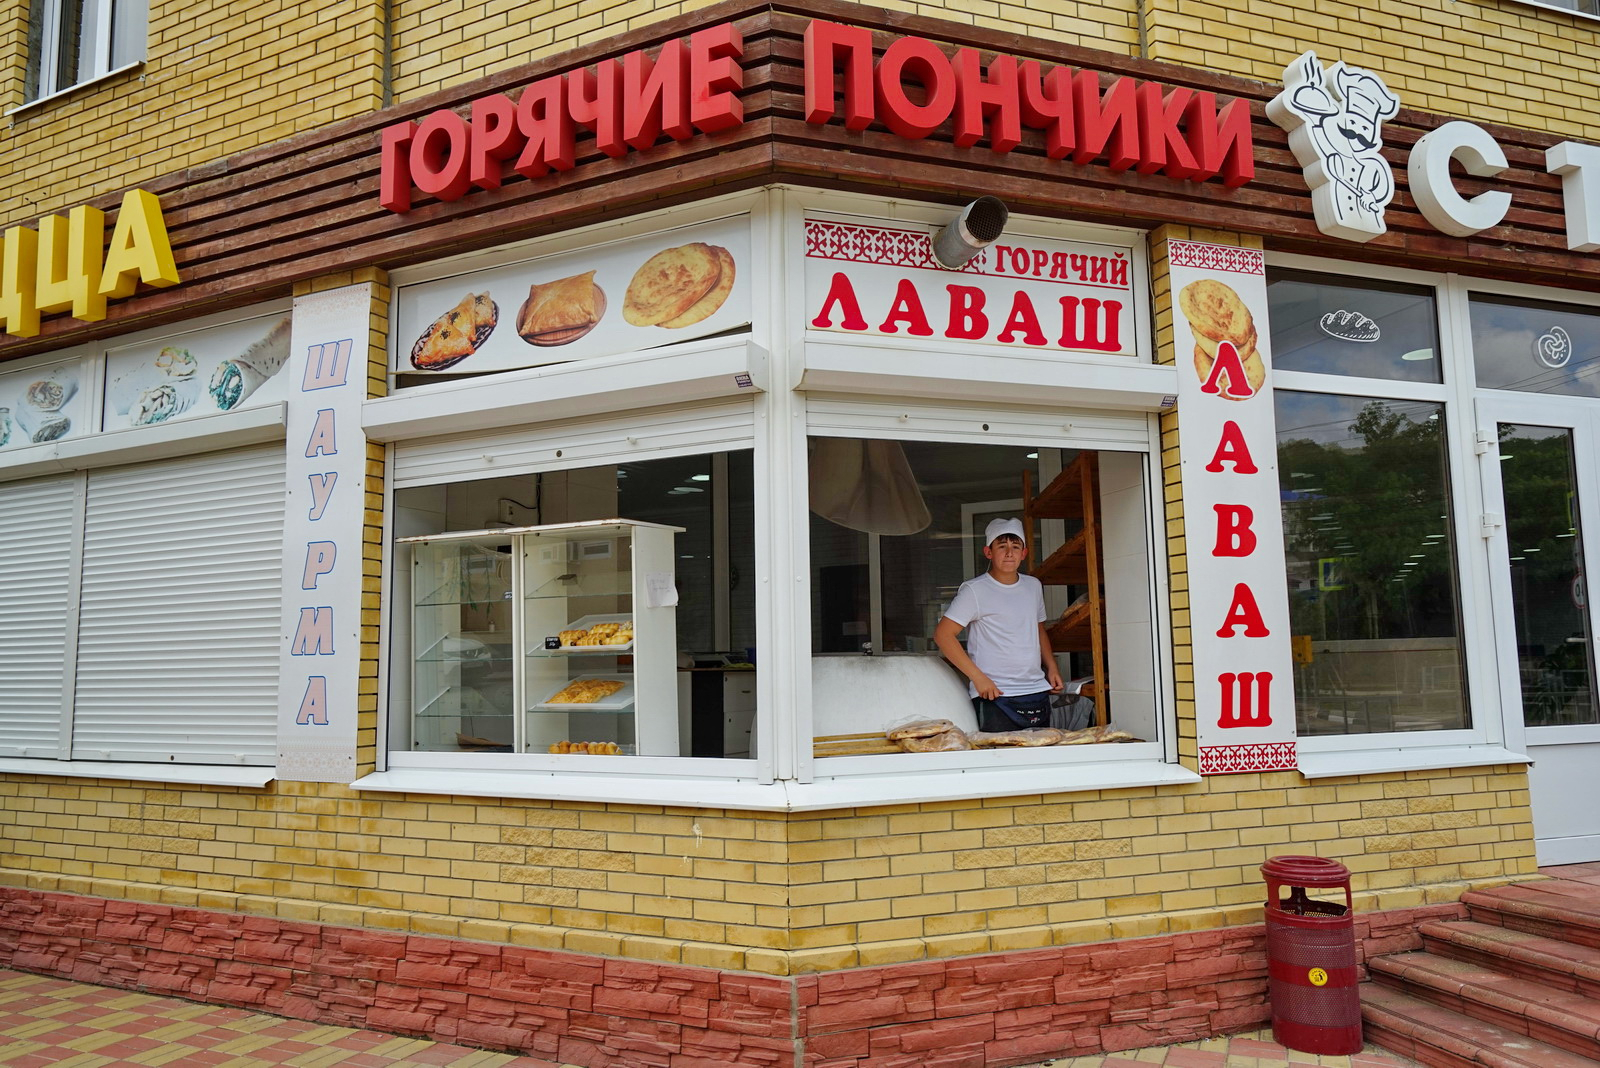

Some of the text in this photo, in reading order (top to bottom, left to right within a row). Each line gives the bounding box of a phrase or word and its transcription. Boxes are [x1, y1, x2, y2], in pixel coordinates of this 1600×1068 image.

[380, 19, 1255, 213] ГОРЯЧИЕ ПОНЧИКИ
[812, 272, 1123, 352] ЛАВАШ
[995, 244, 1128, 286] ГОРЯЧИЙ
[290, 338, 353, 726] ШАУРМА
[1200, 342, 1273, 729] ЛАВАШ
